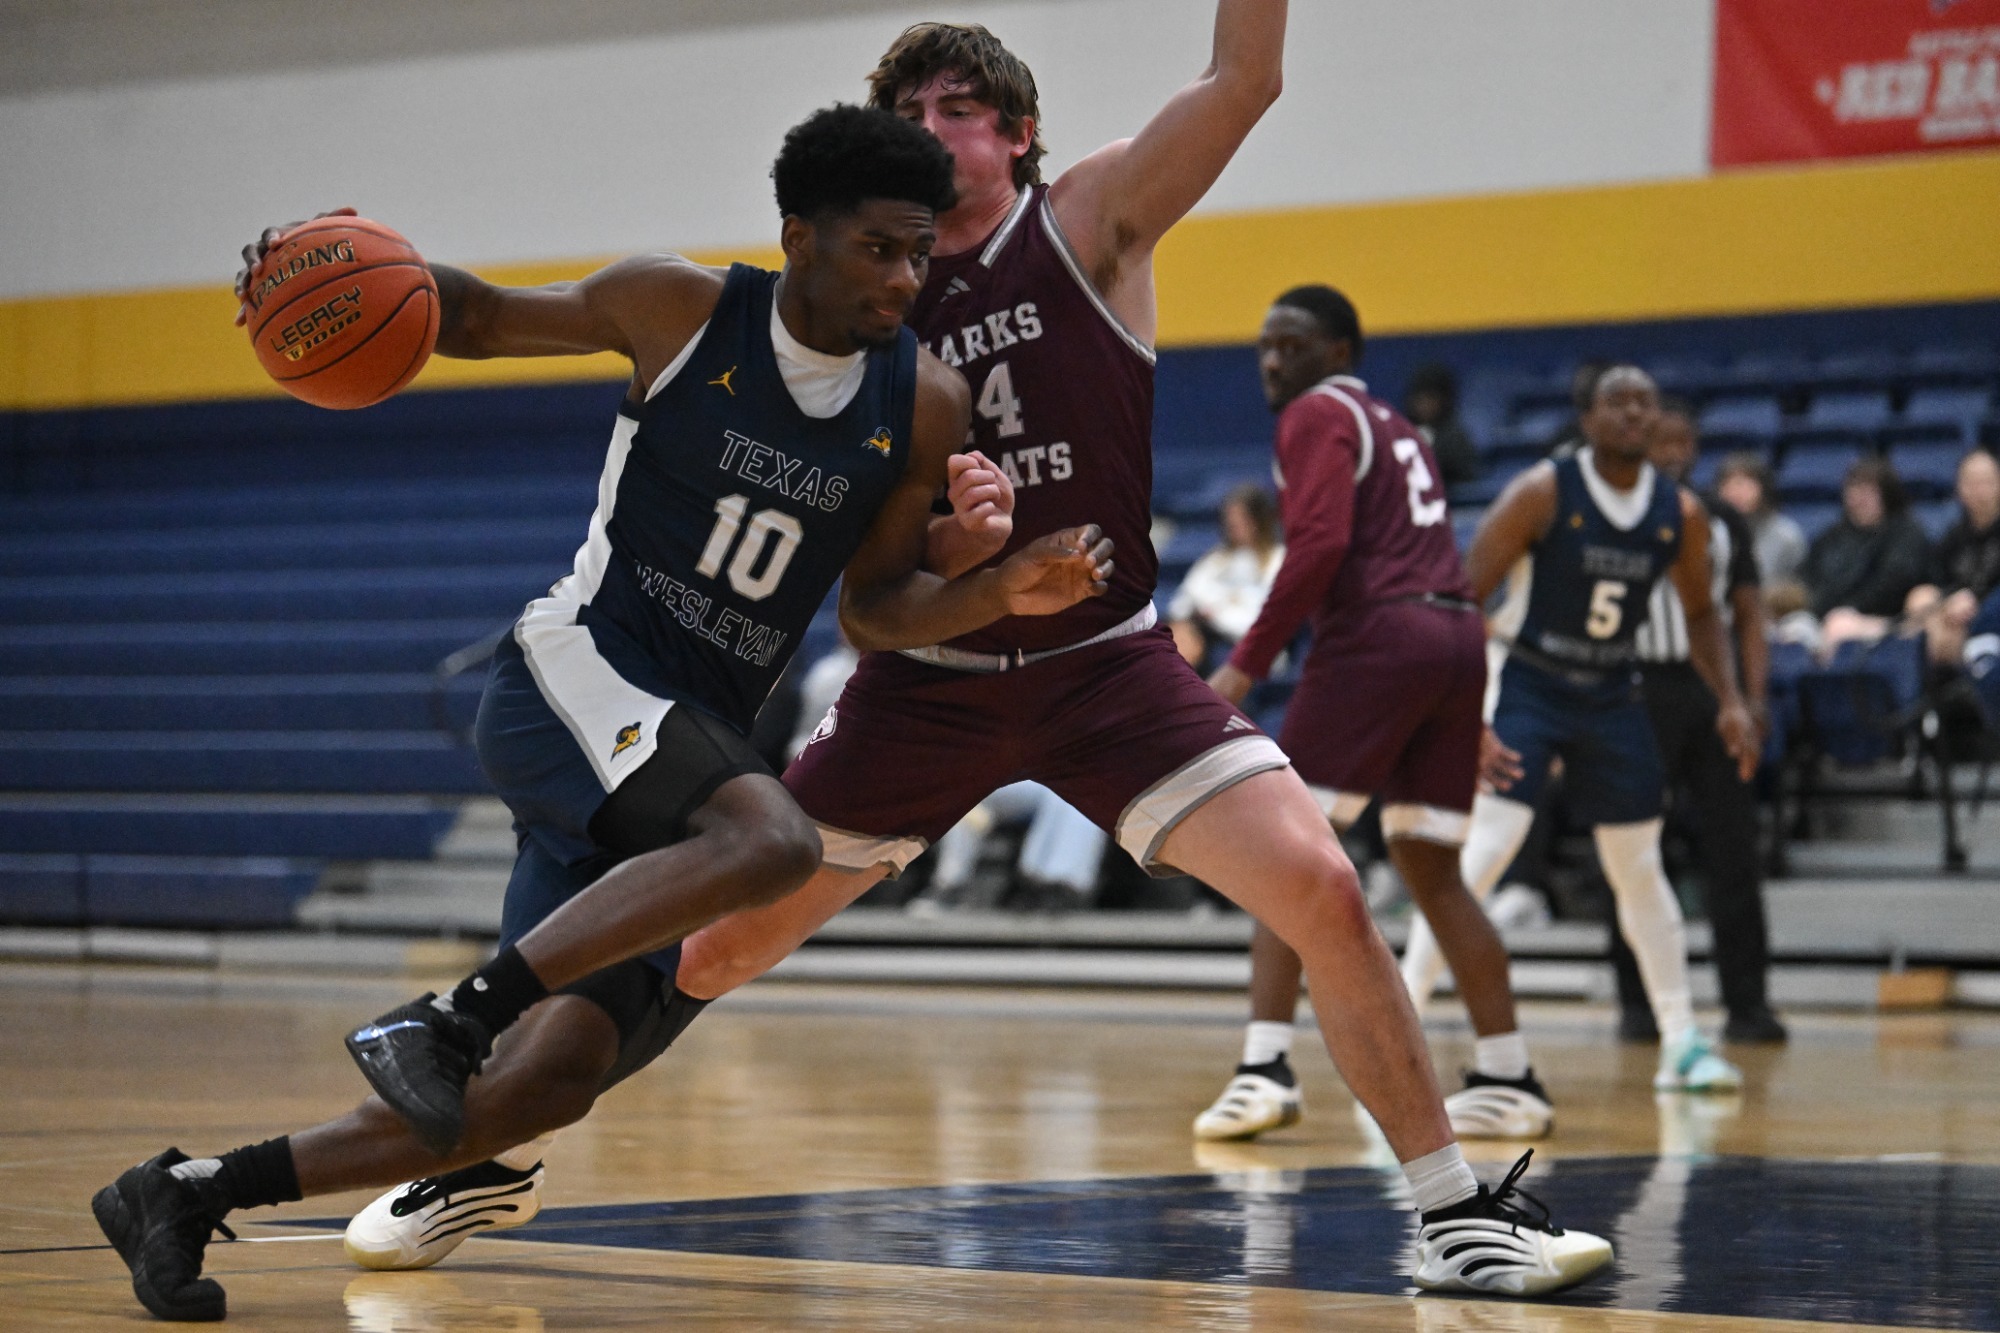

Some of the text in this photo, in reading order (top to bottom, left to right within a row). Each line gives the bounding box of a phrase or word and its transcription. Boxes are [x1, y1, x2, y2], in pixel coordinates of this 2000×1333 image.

[270, 285, 362, 353] LEGACY
[304, 310, 362, 350] 1000
[928, 301, 1043, 368] ARKS
[965, 360, 1025, 444] 4
[719, 429, 849, 512] TEXAS
[1000, 441, 1073, 489] ATS
[1391, 437, 1447, 527] 2
[695, 492, 804, 602] 10
[634, 559, 788, 668] WESLEYAN
[1584, 579, 1628, 640] 5
